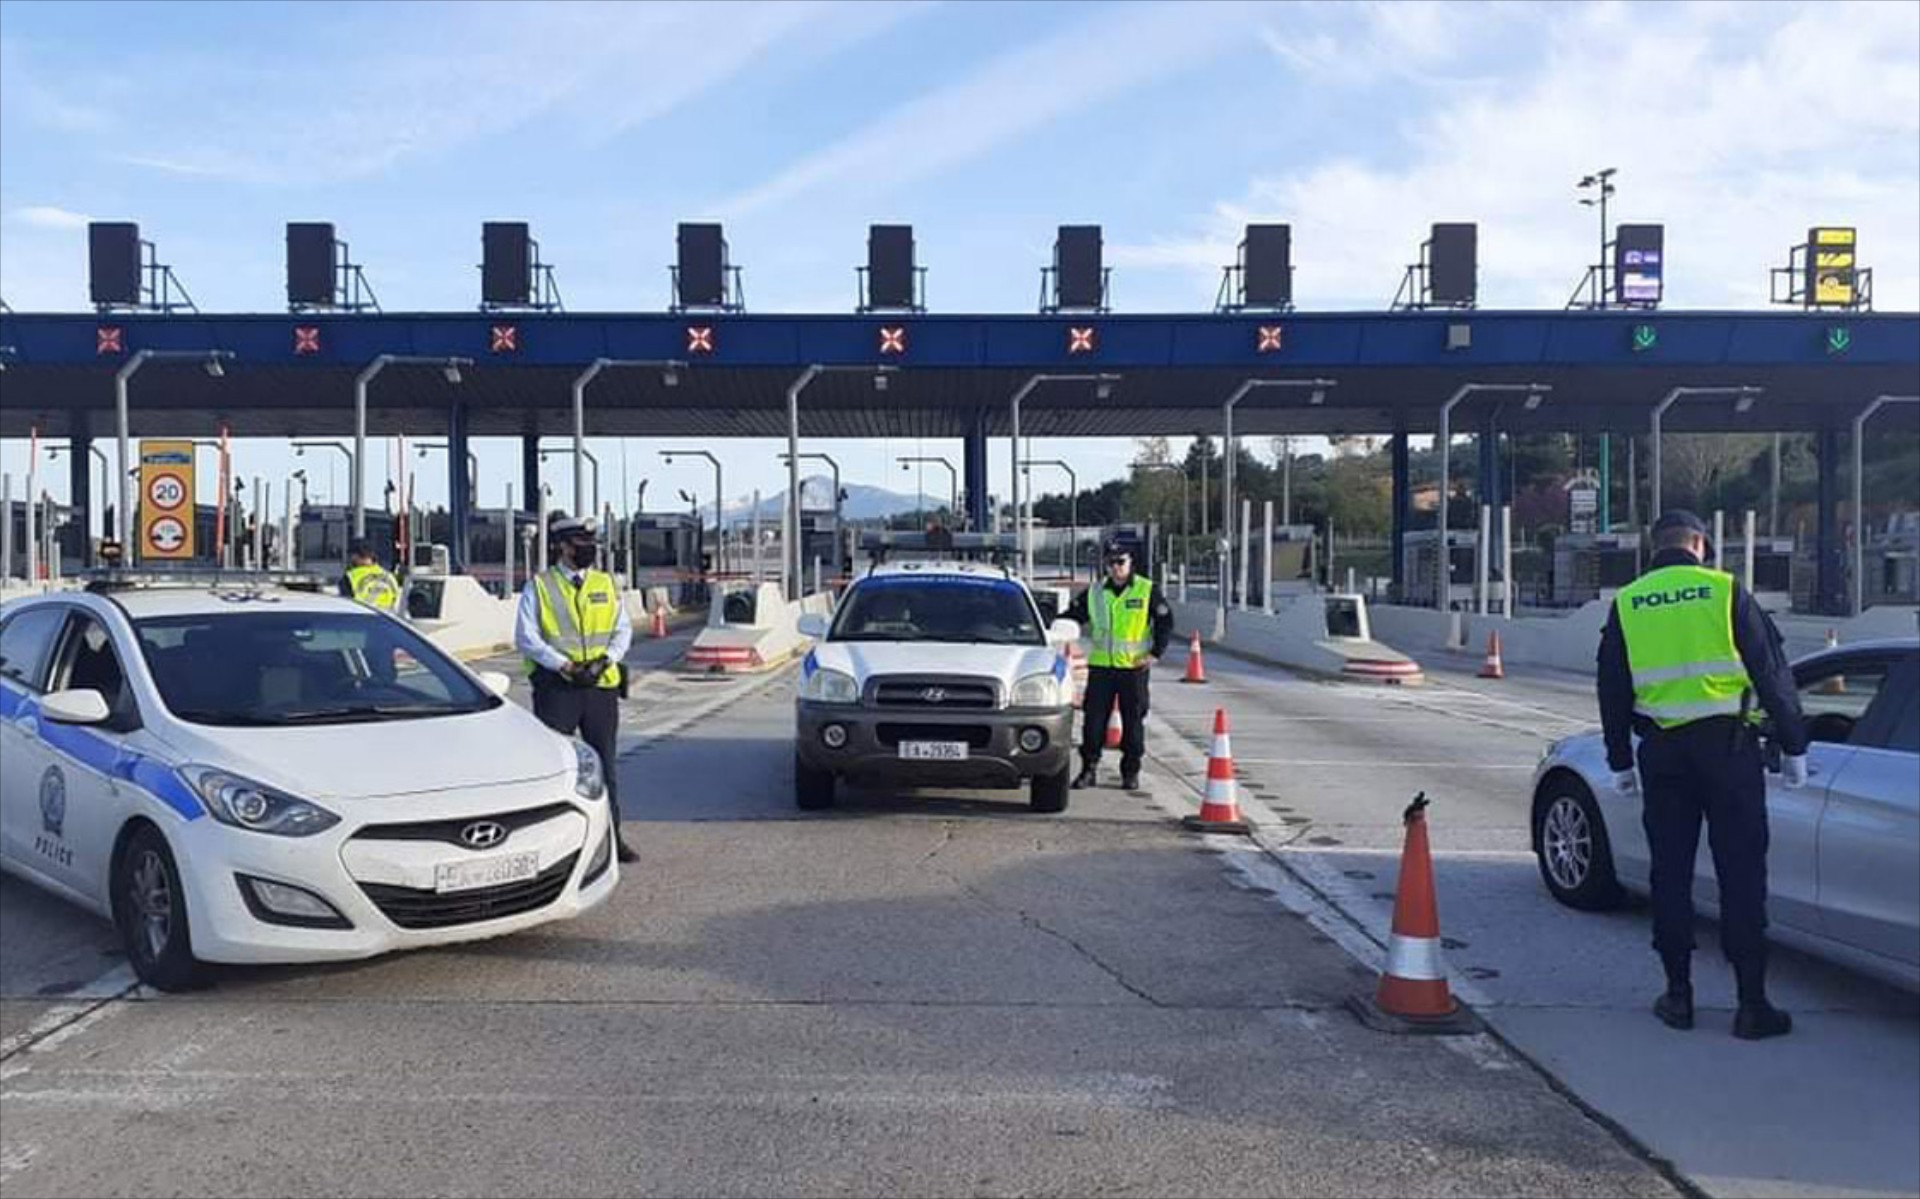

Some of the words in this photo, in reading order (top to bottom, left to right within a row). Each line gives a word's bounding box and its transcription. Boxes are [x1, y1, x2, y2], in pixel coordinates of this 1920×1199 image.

[156, 484, 179, 500] 20
[1631, 586, 1713, 610] POLICE
[34, 836, 74, 867] POLICE
